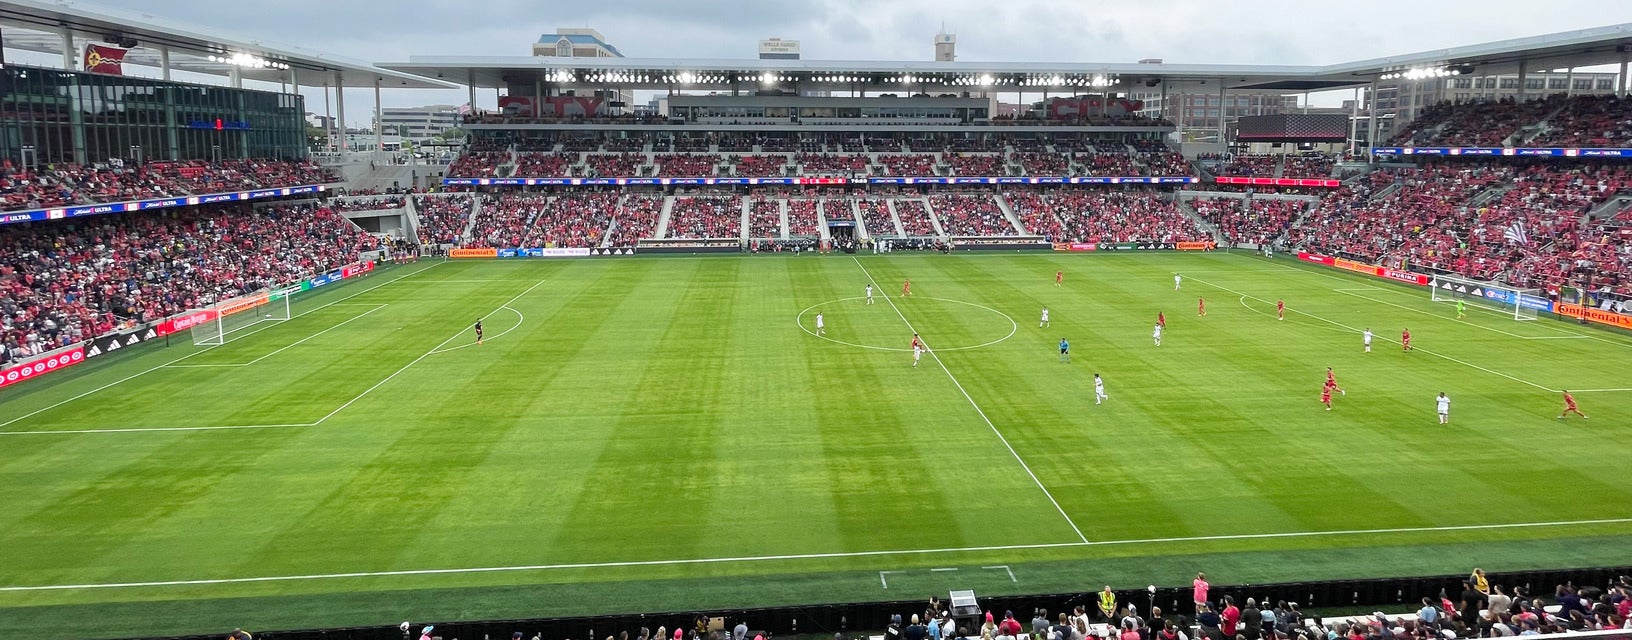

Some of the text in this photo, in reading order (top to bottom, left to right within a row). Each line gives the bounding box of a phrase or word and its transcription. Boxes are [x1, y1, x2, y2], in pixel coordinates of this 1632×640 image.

[498, 96, 605, 119] CITY
[94, 206, 112, 214] ULTRA
[9, 214, 31, 223] ULTRA
[1390, 272, 1417, 282] PURINA
[1557, 304, 1620, 324] Continental
